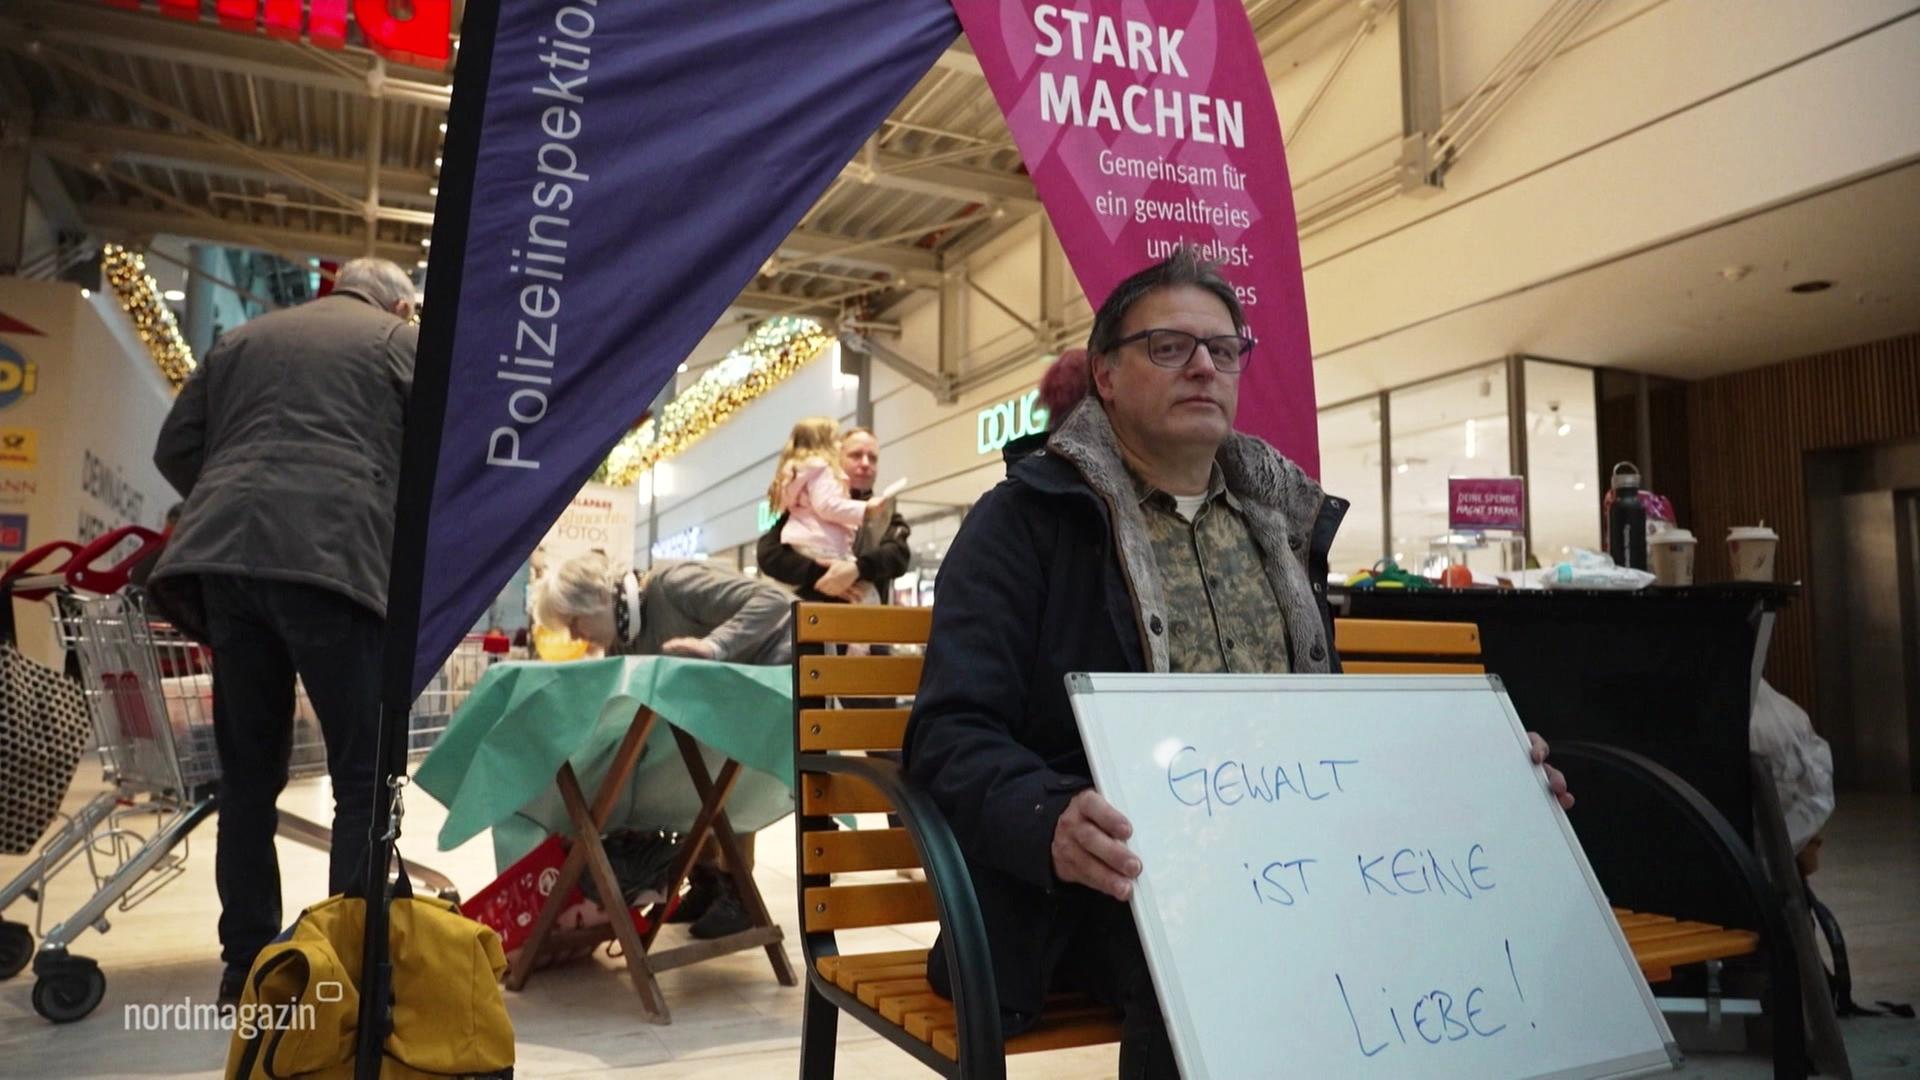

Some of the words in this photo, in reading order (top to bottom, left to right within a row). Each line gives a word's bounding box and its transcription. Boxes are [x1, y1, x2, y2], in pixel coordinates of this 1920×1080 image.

[1034, 4, 1188, 78] STARK
[1039, 72, 1245, 148] MACHEN
[1099, 150, 1217, 187] Gemeinsam
[1222, 164, 1246, 190] für
[1096, 190, 1127, 216] ein
[1134, 197, 1250, 229] gewaltfreies
[1168, 746, 1359, 816] GEWALT
